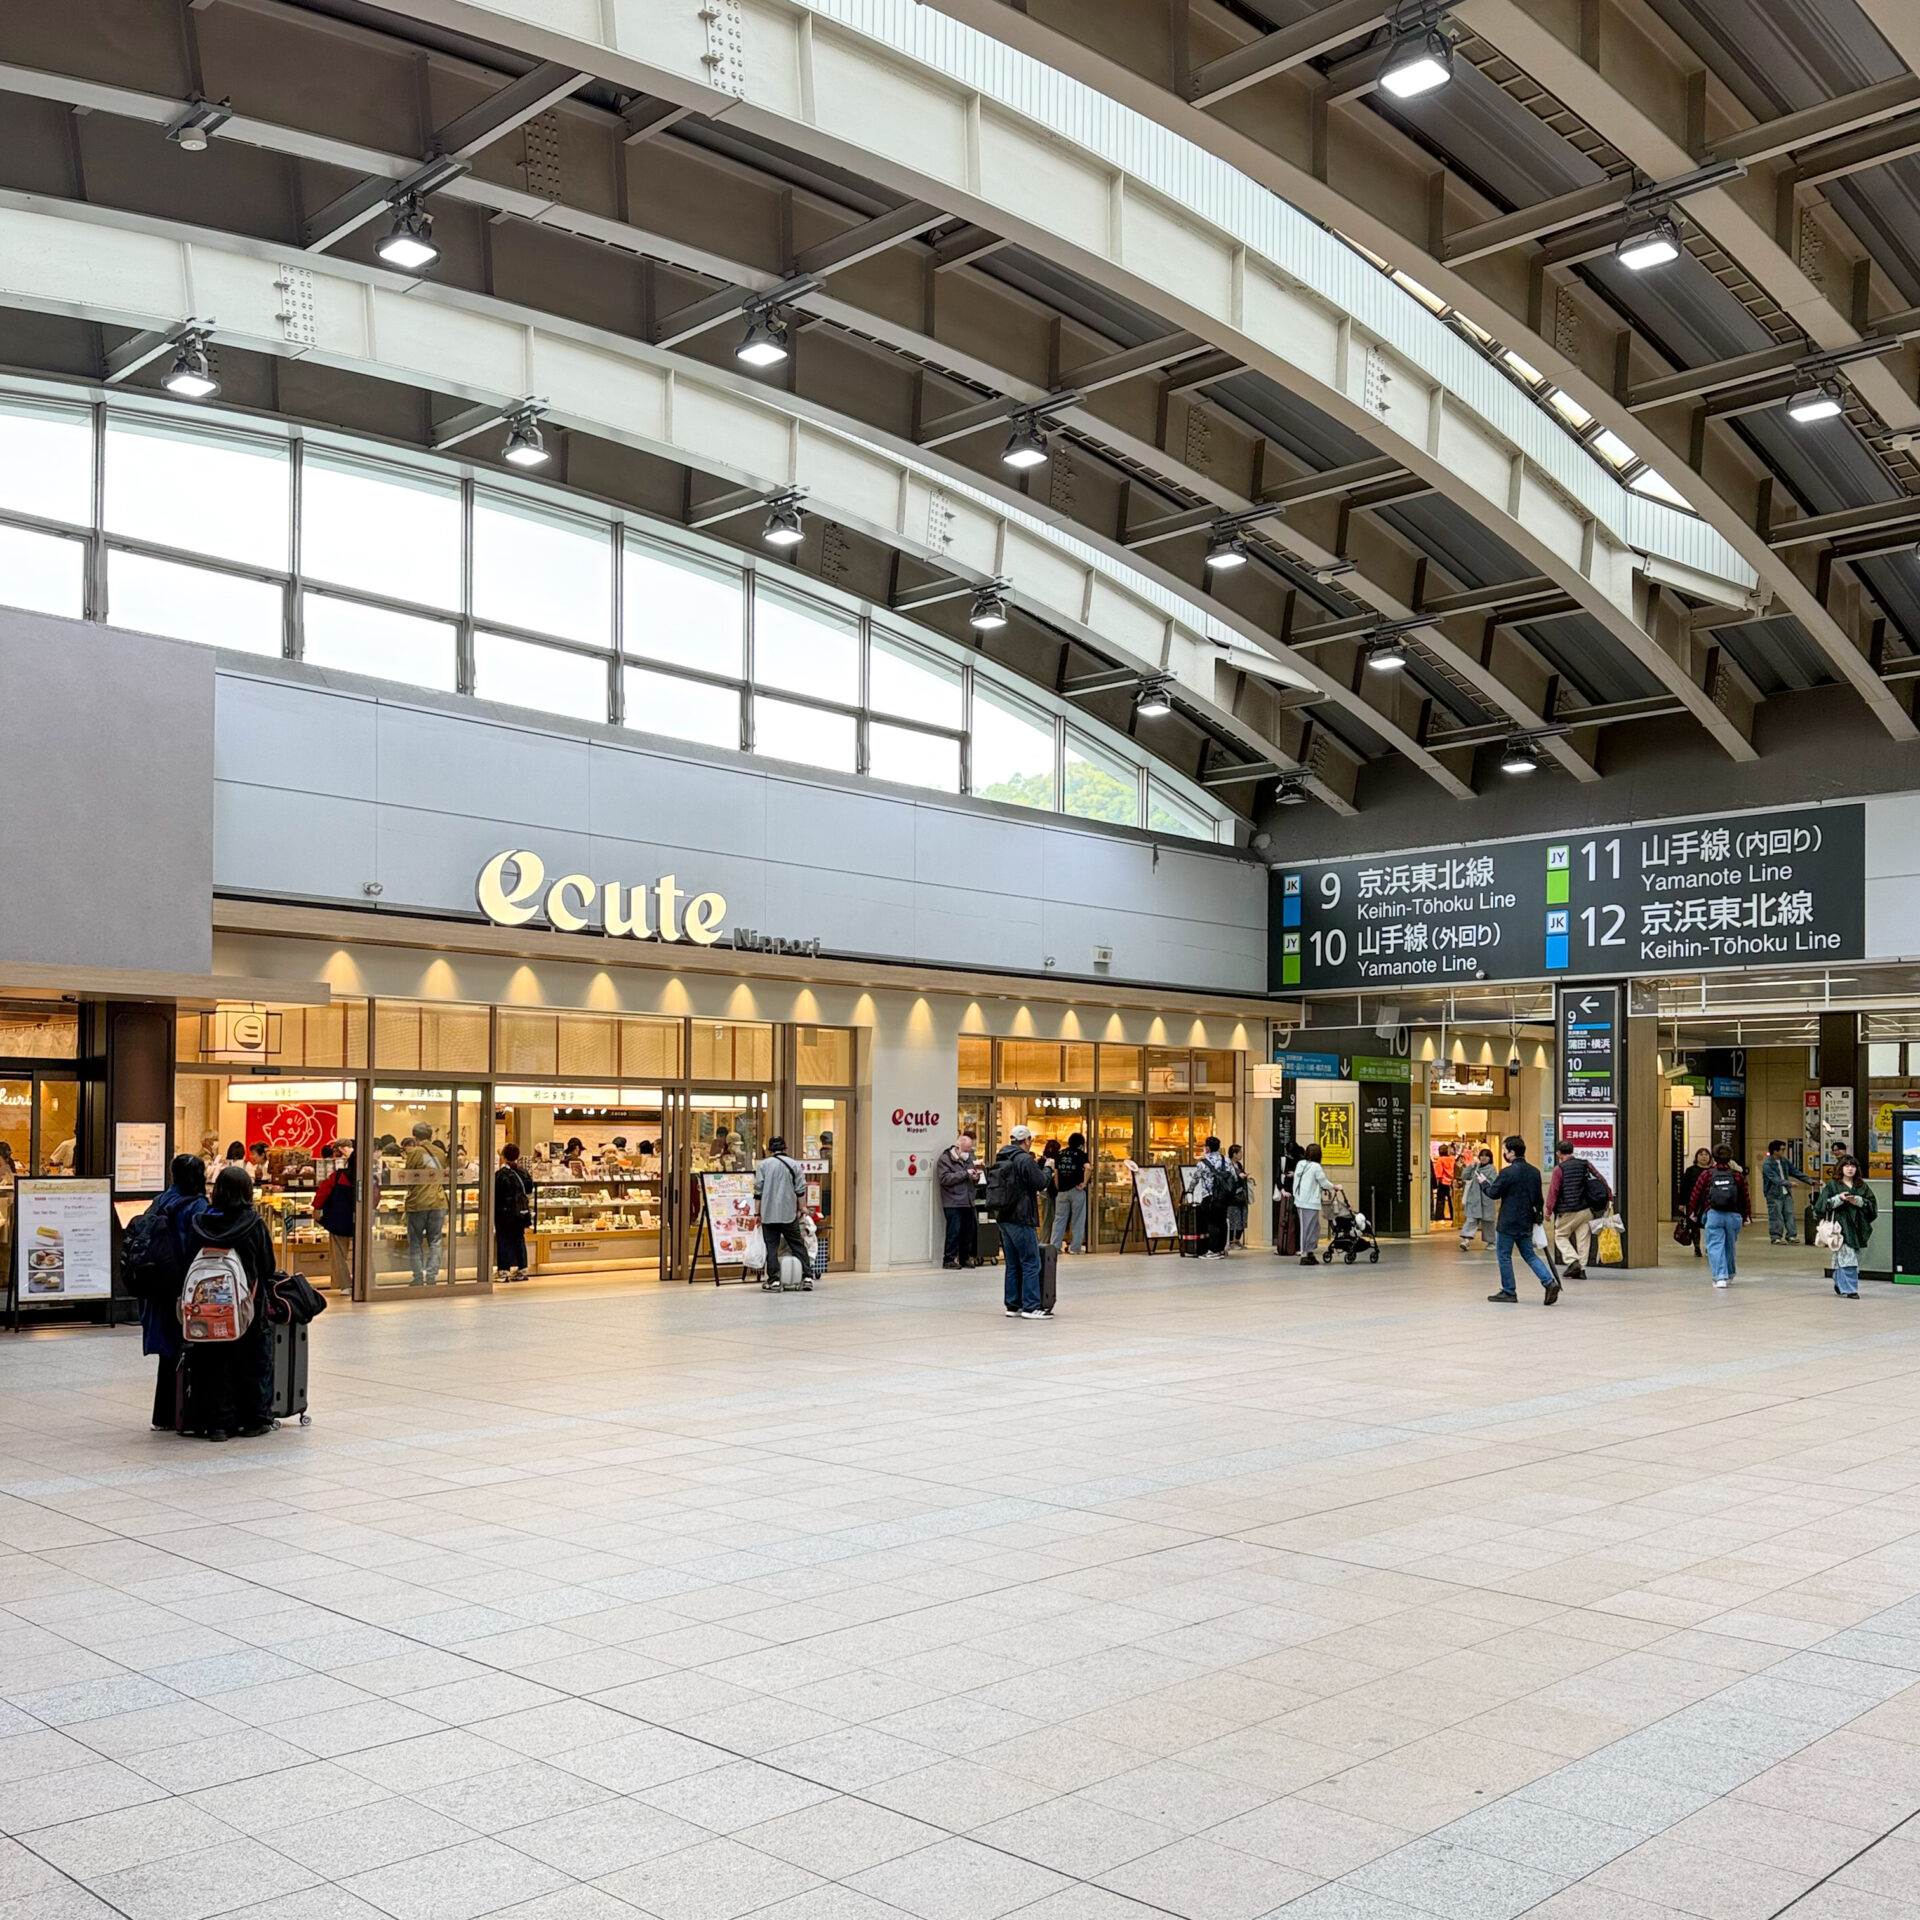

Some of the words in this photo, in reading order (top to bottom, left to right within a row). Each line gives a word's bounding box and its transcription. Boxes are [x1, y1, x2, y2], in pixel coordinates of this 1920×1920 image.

[1551, 851, 1565, 864] JY
[1580, 838, 1621, 881] 11
[1286, 879, 1299, 891] JK
[1357, 855, 1495, 899] 京浜東北線
[1641, 868, 1742, 892] Yamanote
[1748, 863, 1793, 883] Line
[475, 849, 727, 945] ecute
[1319, 872, 1341, 910] 9
[1357, 895, 1474, 920] Keihin-Tōhoku
[1479, 891, 1516, 910] Line
[1640, 890, 1814, 936] 京浜東北線
[1550, 916, 1564, 930] JK
[1580, 904, 1626, 947] 12
[733, 927, 821, 958] Nippori
[1286, 936, 1299, 949] JY
[1309, 928, 1347, 967] 10
[1641, 934, 1788, 960] Keihin-Tōhoku
[1795, 930, 1841, 951] Line
[1357, 957, 1437, 977] Yamanote
[1442, 954, 1477, 972] Line
[1568, 1010, 1577, 1024] 9
[1568, 1057, 1582, 1071] 10
[1730, 1050, 1744, 1077] 12
[1290, 1094, 1296, 1105] 9
[1568, 1086, 1610, 1097] 東京・品川
[1377, 1097, 1388, 1108] 10
[892, 1108, 940, 1126] ecute
[1321, 1111, 1348, 1122] とまる
[1727, 1109, 1737, 1117] 12
[1566, 1130, 1610, 1139] 三井のリハウス
